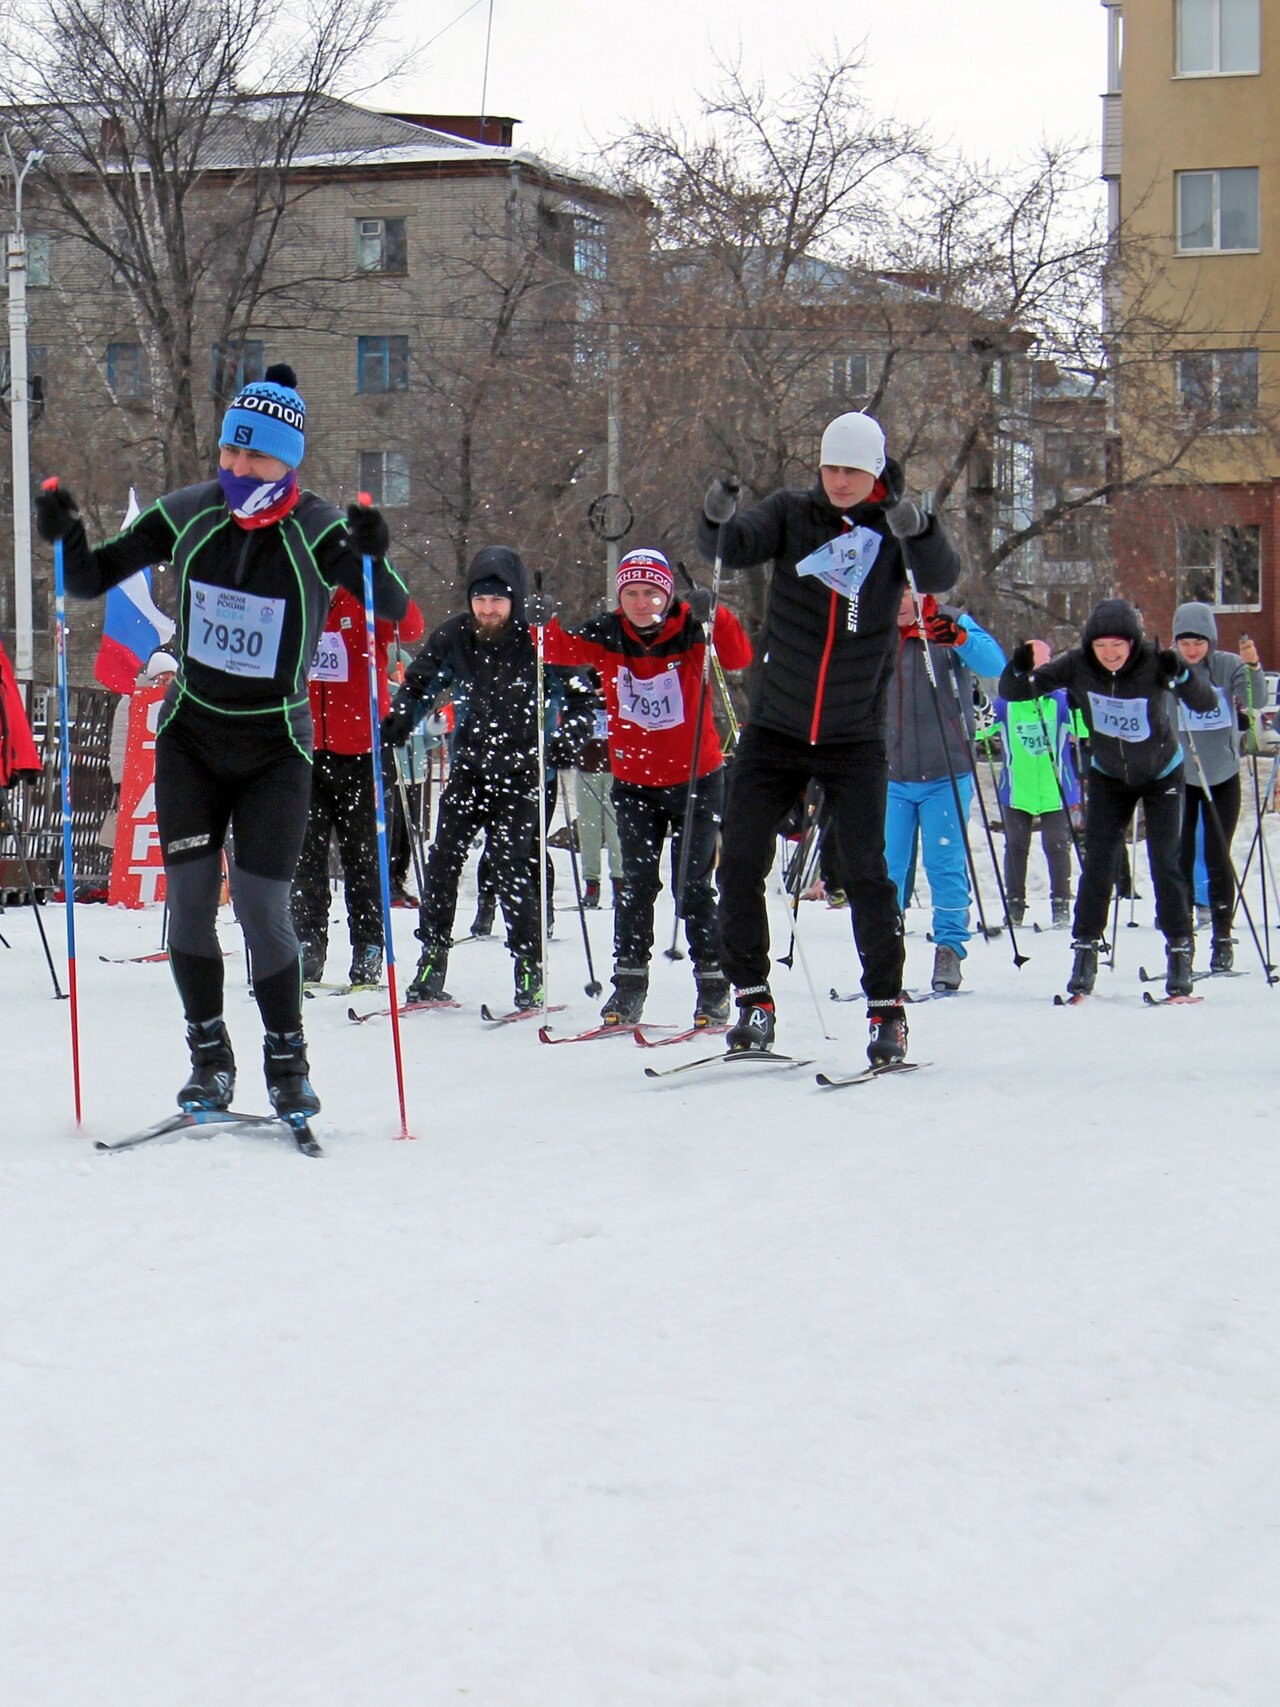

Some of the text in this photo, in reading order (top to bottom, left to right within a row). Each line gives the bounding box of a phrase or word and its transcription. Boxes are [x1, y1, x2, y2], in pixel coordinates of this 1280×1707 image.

[228, 397, 303, 429] Lomon
[202, 618, 263, 657] 7930
[311, 651, 339, 669] 928
[629, 693, 671, 718] 7931
[128, 699, 167, 903] САРТ
